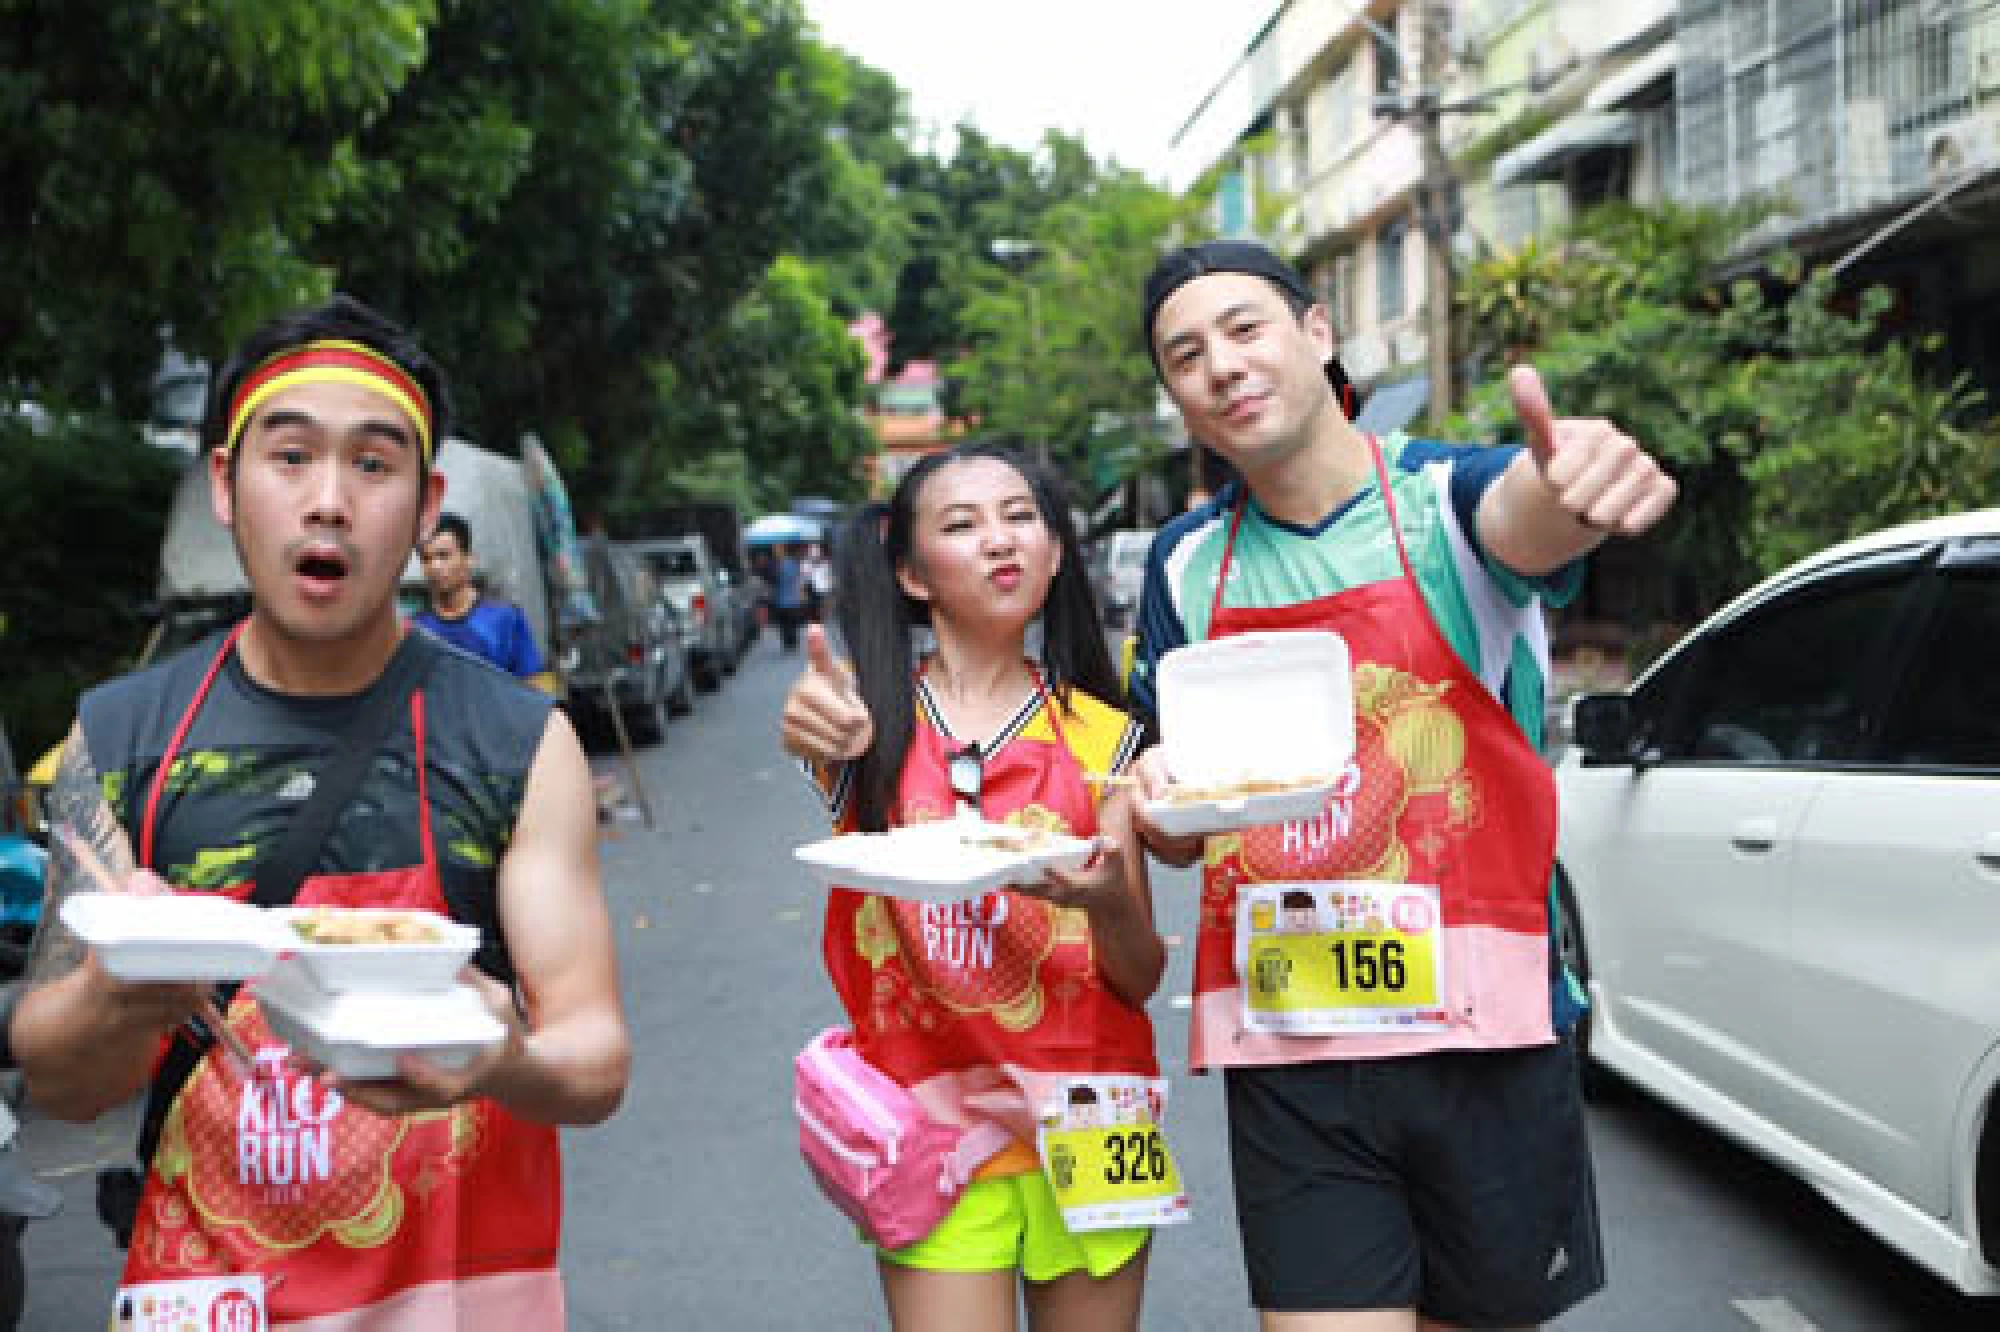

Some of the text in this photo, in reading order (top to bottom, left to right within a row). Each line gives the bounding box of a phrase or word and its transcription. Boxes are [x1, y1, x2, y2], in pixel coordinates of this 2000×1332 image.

[923, 926, 993, 969] RUN
[1332, 939, 1406, 992] 156
[238, 1127, 331, 1184] RUN
[1104, 1131, 1165, 1184] 326
